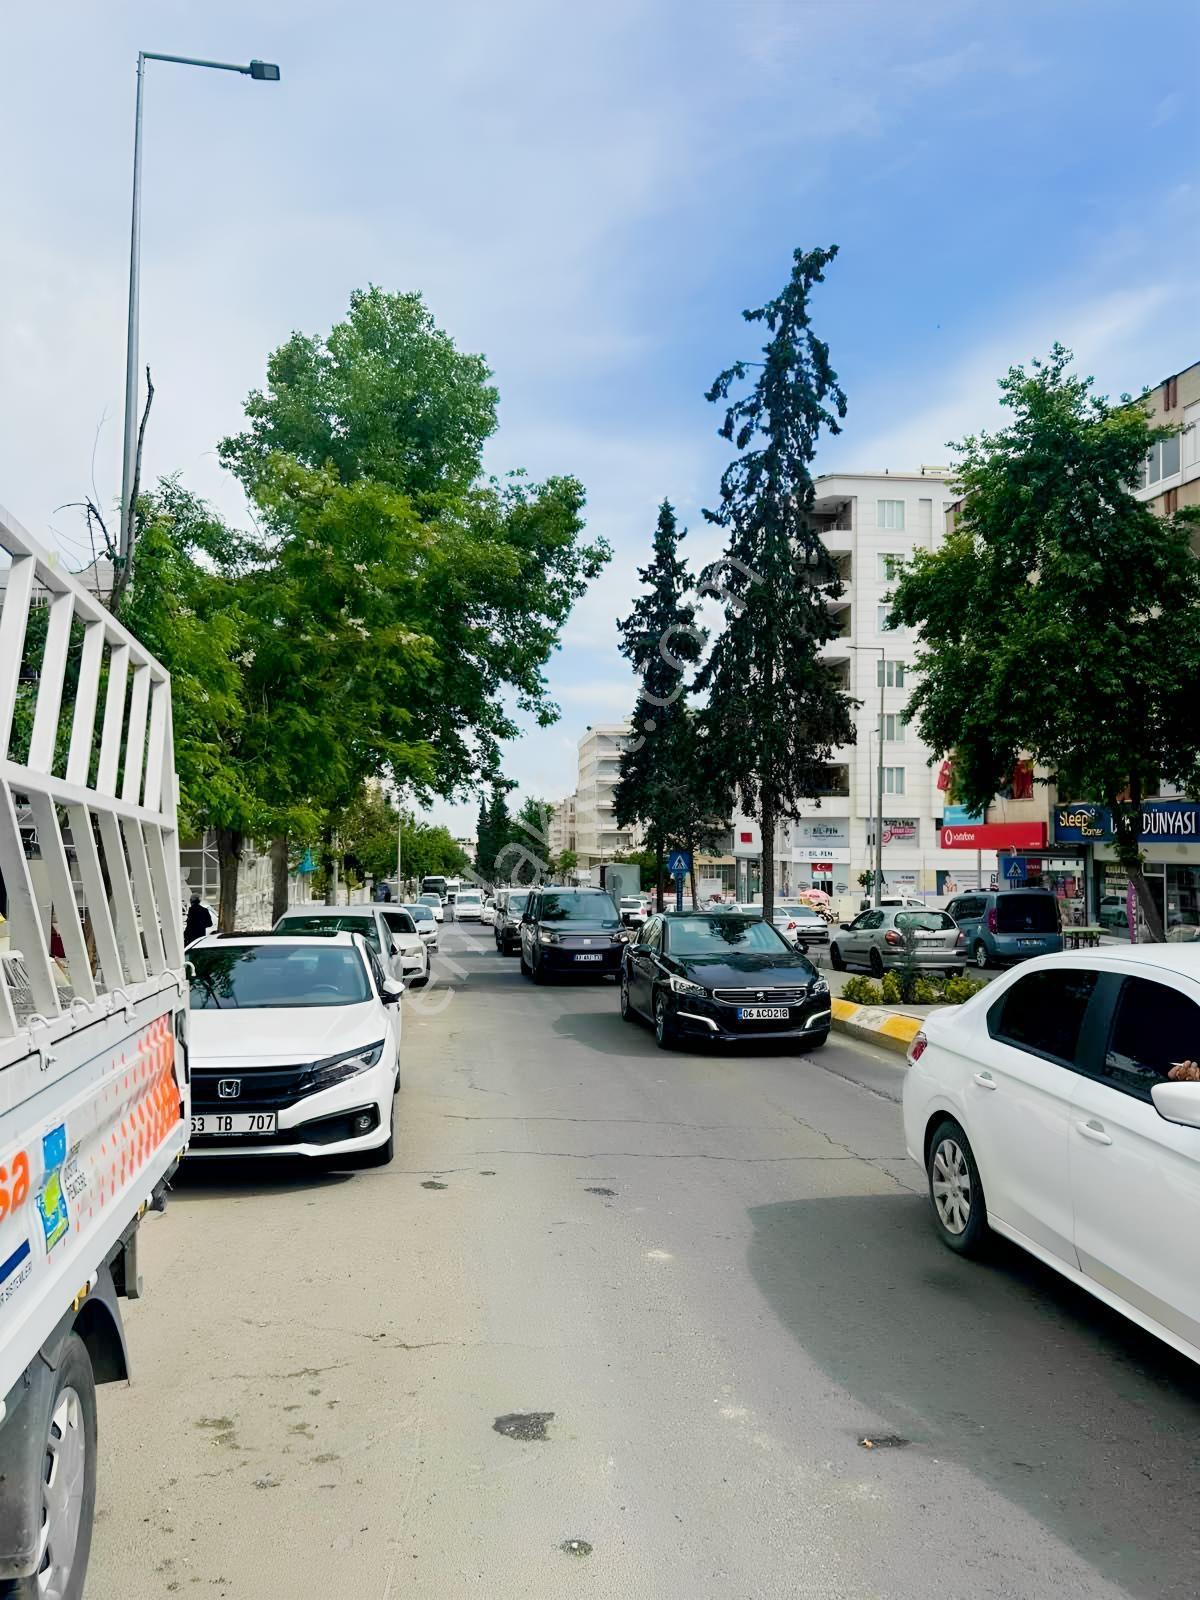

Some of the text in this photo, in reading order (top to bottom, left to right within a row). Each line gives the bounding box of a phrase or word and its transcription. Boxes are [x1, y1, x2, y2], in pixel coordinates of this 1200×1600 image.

[1059, 811, 1089, 829] Sleep
[1142, 808, 1196, 834] DÜNYASI
[743, 1009, 754, 1018] 06
[216, 1116, 233, 1131] TB
[248, 1114, 274, 1131] 707
